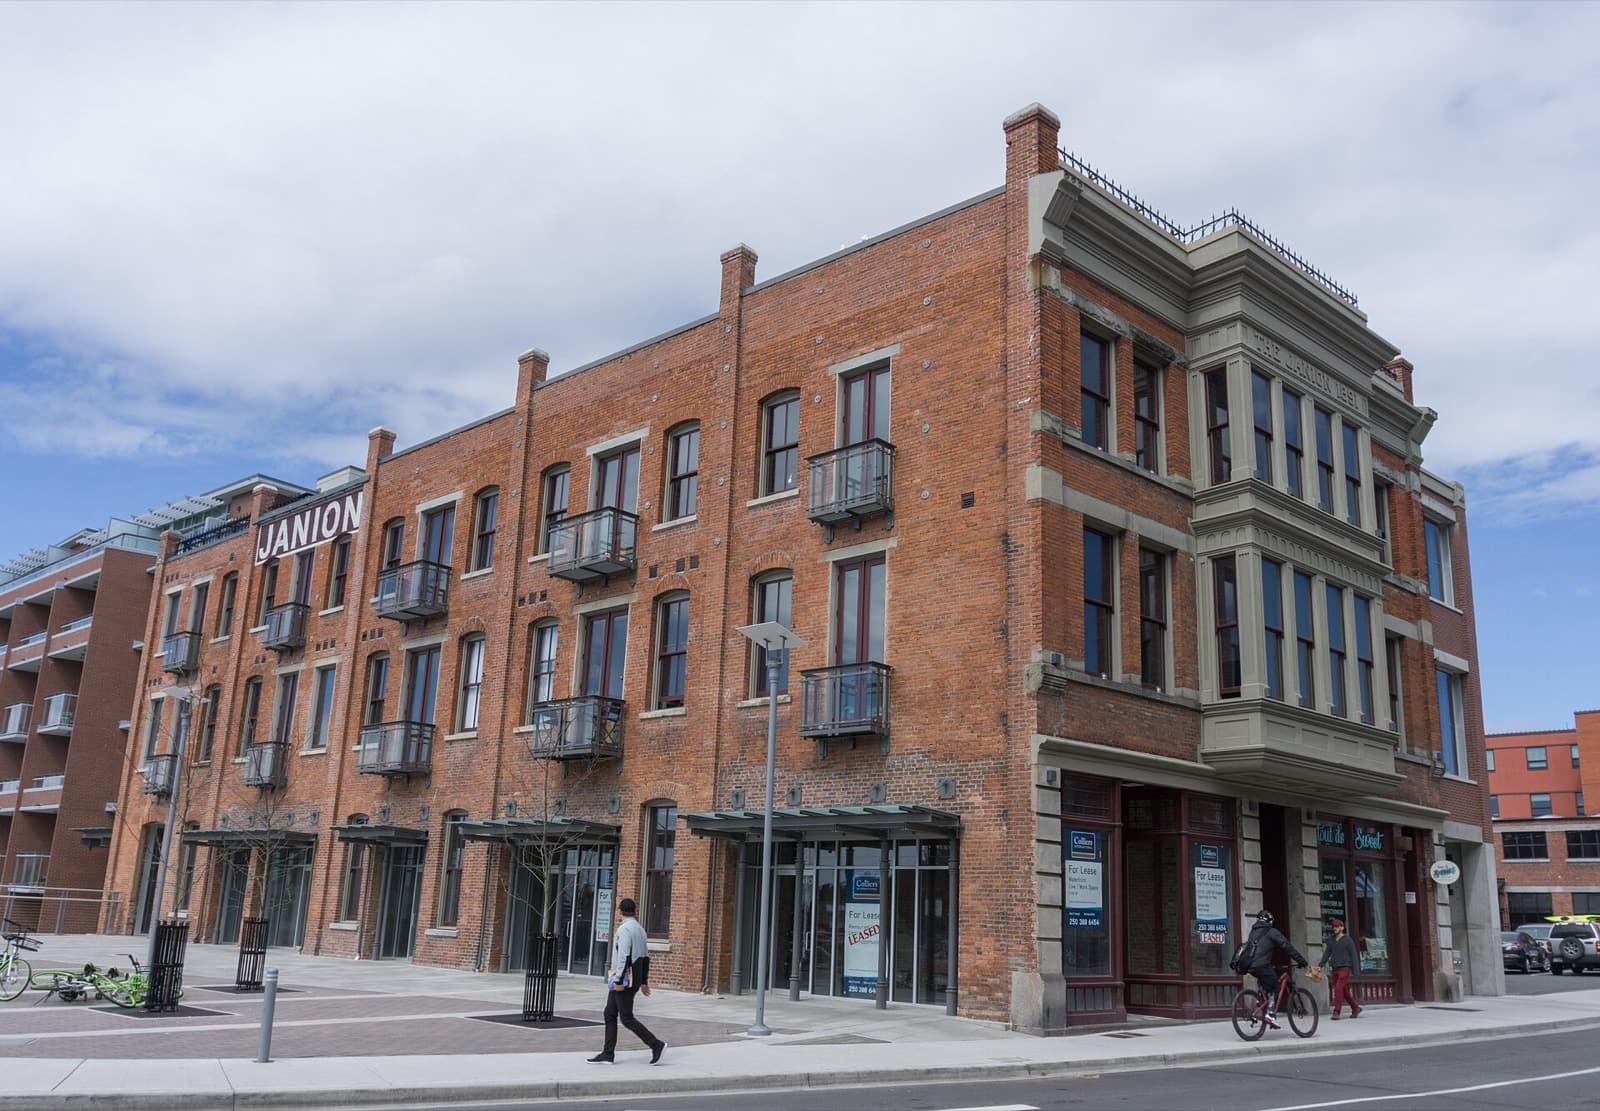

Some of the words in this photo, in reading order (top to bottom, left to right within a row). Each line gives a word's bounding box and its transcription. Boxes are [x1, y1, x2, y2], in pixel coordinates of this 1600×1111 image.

[1254, 334, 1280, 363] THE
[258, 491, 364, 560] JANION
[1068, 864, 1079, 874] For
[1080, 866, 1097, 876] Lease
[1197, 871, 1206, 880] For
[1207, 872, 1224, 882] Lease
[856, 879, 878, 889] Colliers
[600, 892, 609, 900] For
[849, 910, 861, 919] For
[848, 924, 880, 945] LEASED
[1200, 932, 1225, 944] LEASED
[1361, 987, 1393, 998] TREATS
